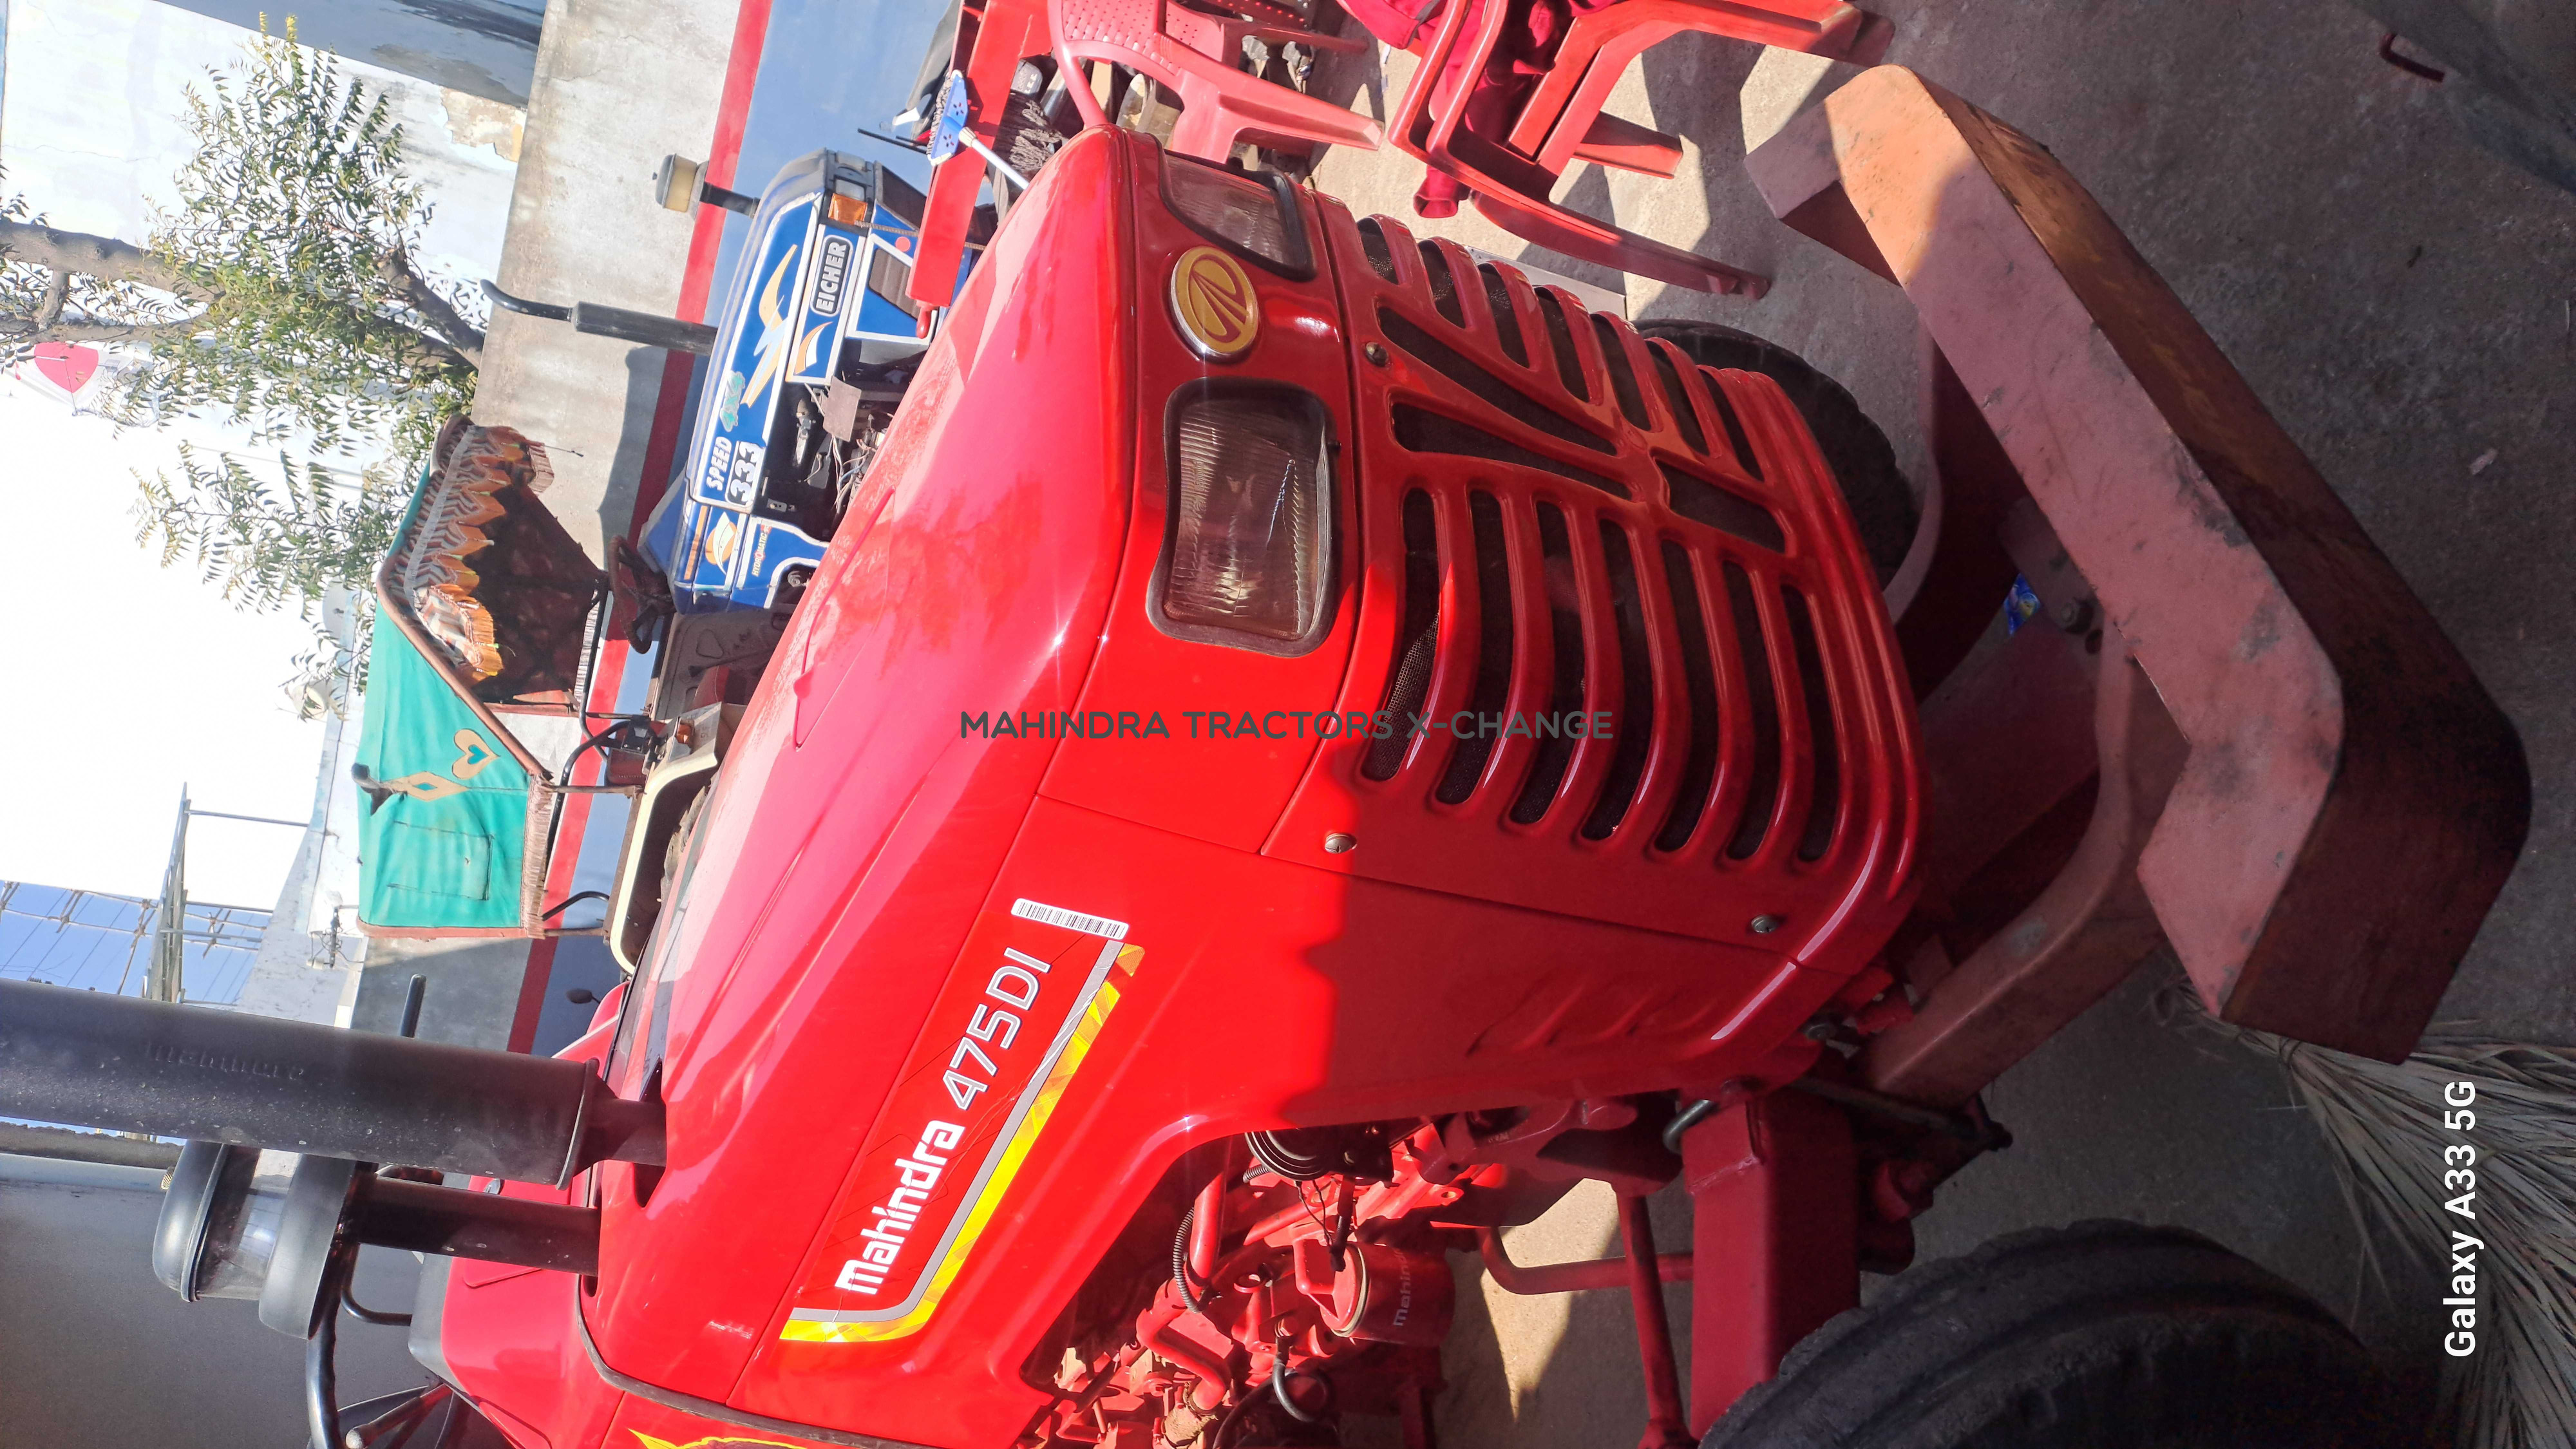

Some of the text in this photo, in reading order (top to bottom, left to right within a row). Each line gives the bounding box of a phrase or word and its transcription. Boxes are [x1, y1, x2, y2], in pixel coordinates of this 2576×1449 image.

[815, 242, 847, 312] EICHER
[706, 436, 732, 491] SPEED
[730, 441, 762, 503] 333
[752, 531, 768, 577] HYDROMATIC
[943, 946, 1052, 1110] 475DI
